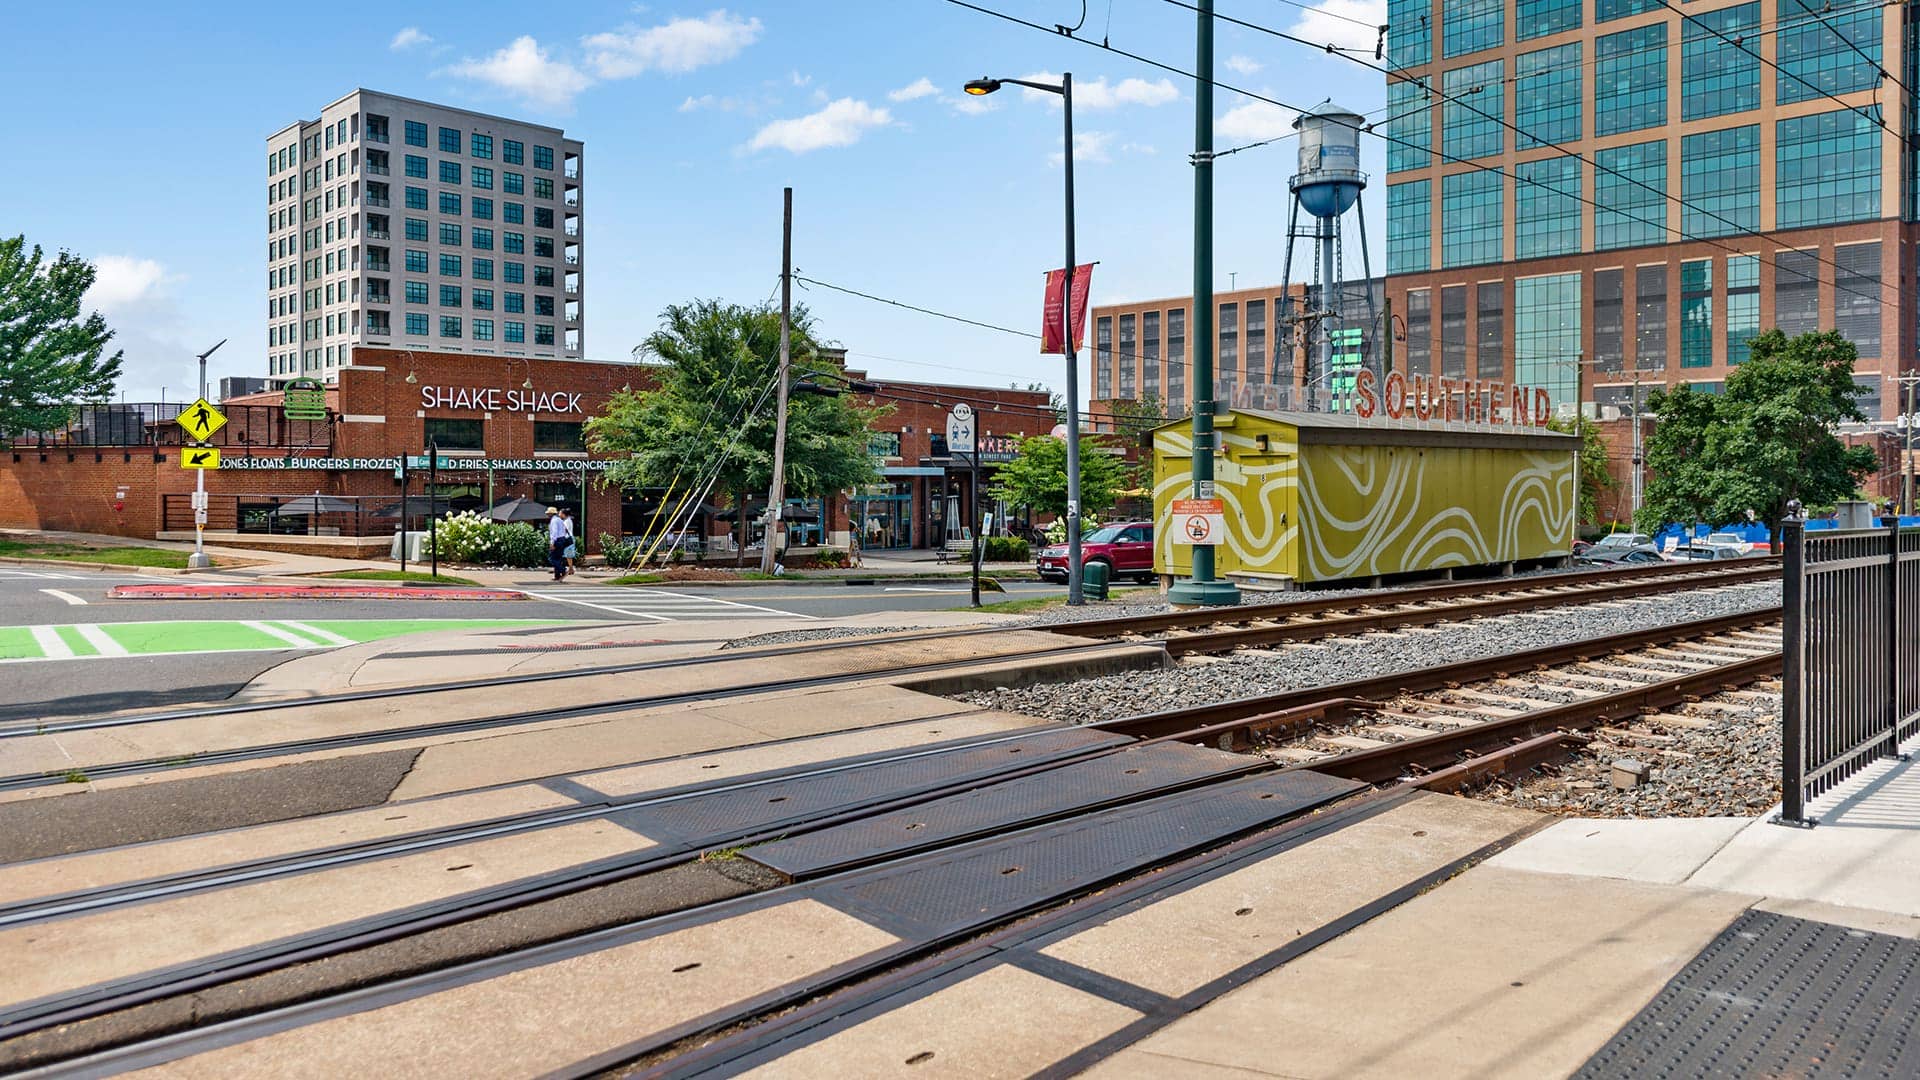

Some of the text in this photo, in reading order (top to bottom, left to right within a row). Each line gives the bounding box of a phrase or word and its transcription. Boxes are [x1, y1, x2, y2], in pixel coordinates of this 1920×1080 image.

[421, 386, 582, 414] SHAKE SHACK
[1354, 367, 1552, 428] SOUTHEND
[219, 458, 285, 469] CONES FLOATS
[291, 458, 350, 469] BURGERS
[353, 458, 402, 469] FROZEN
[460, 459, 489, 470] FRIES
[491, 459, 533, 470] SHAKES
[535, 459, 564, 470] SODA
